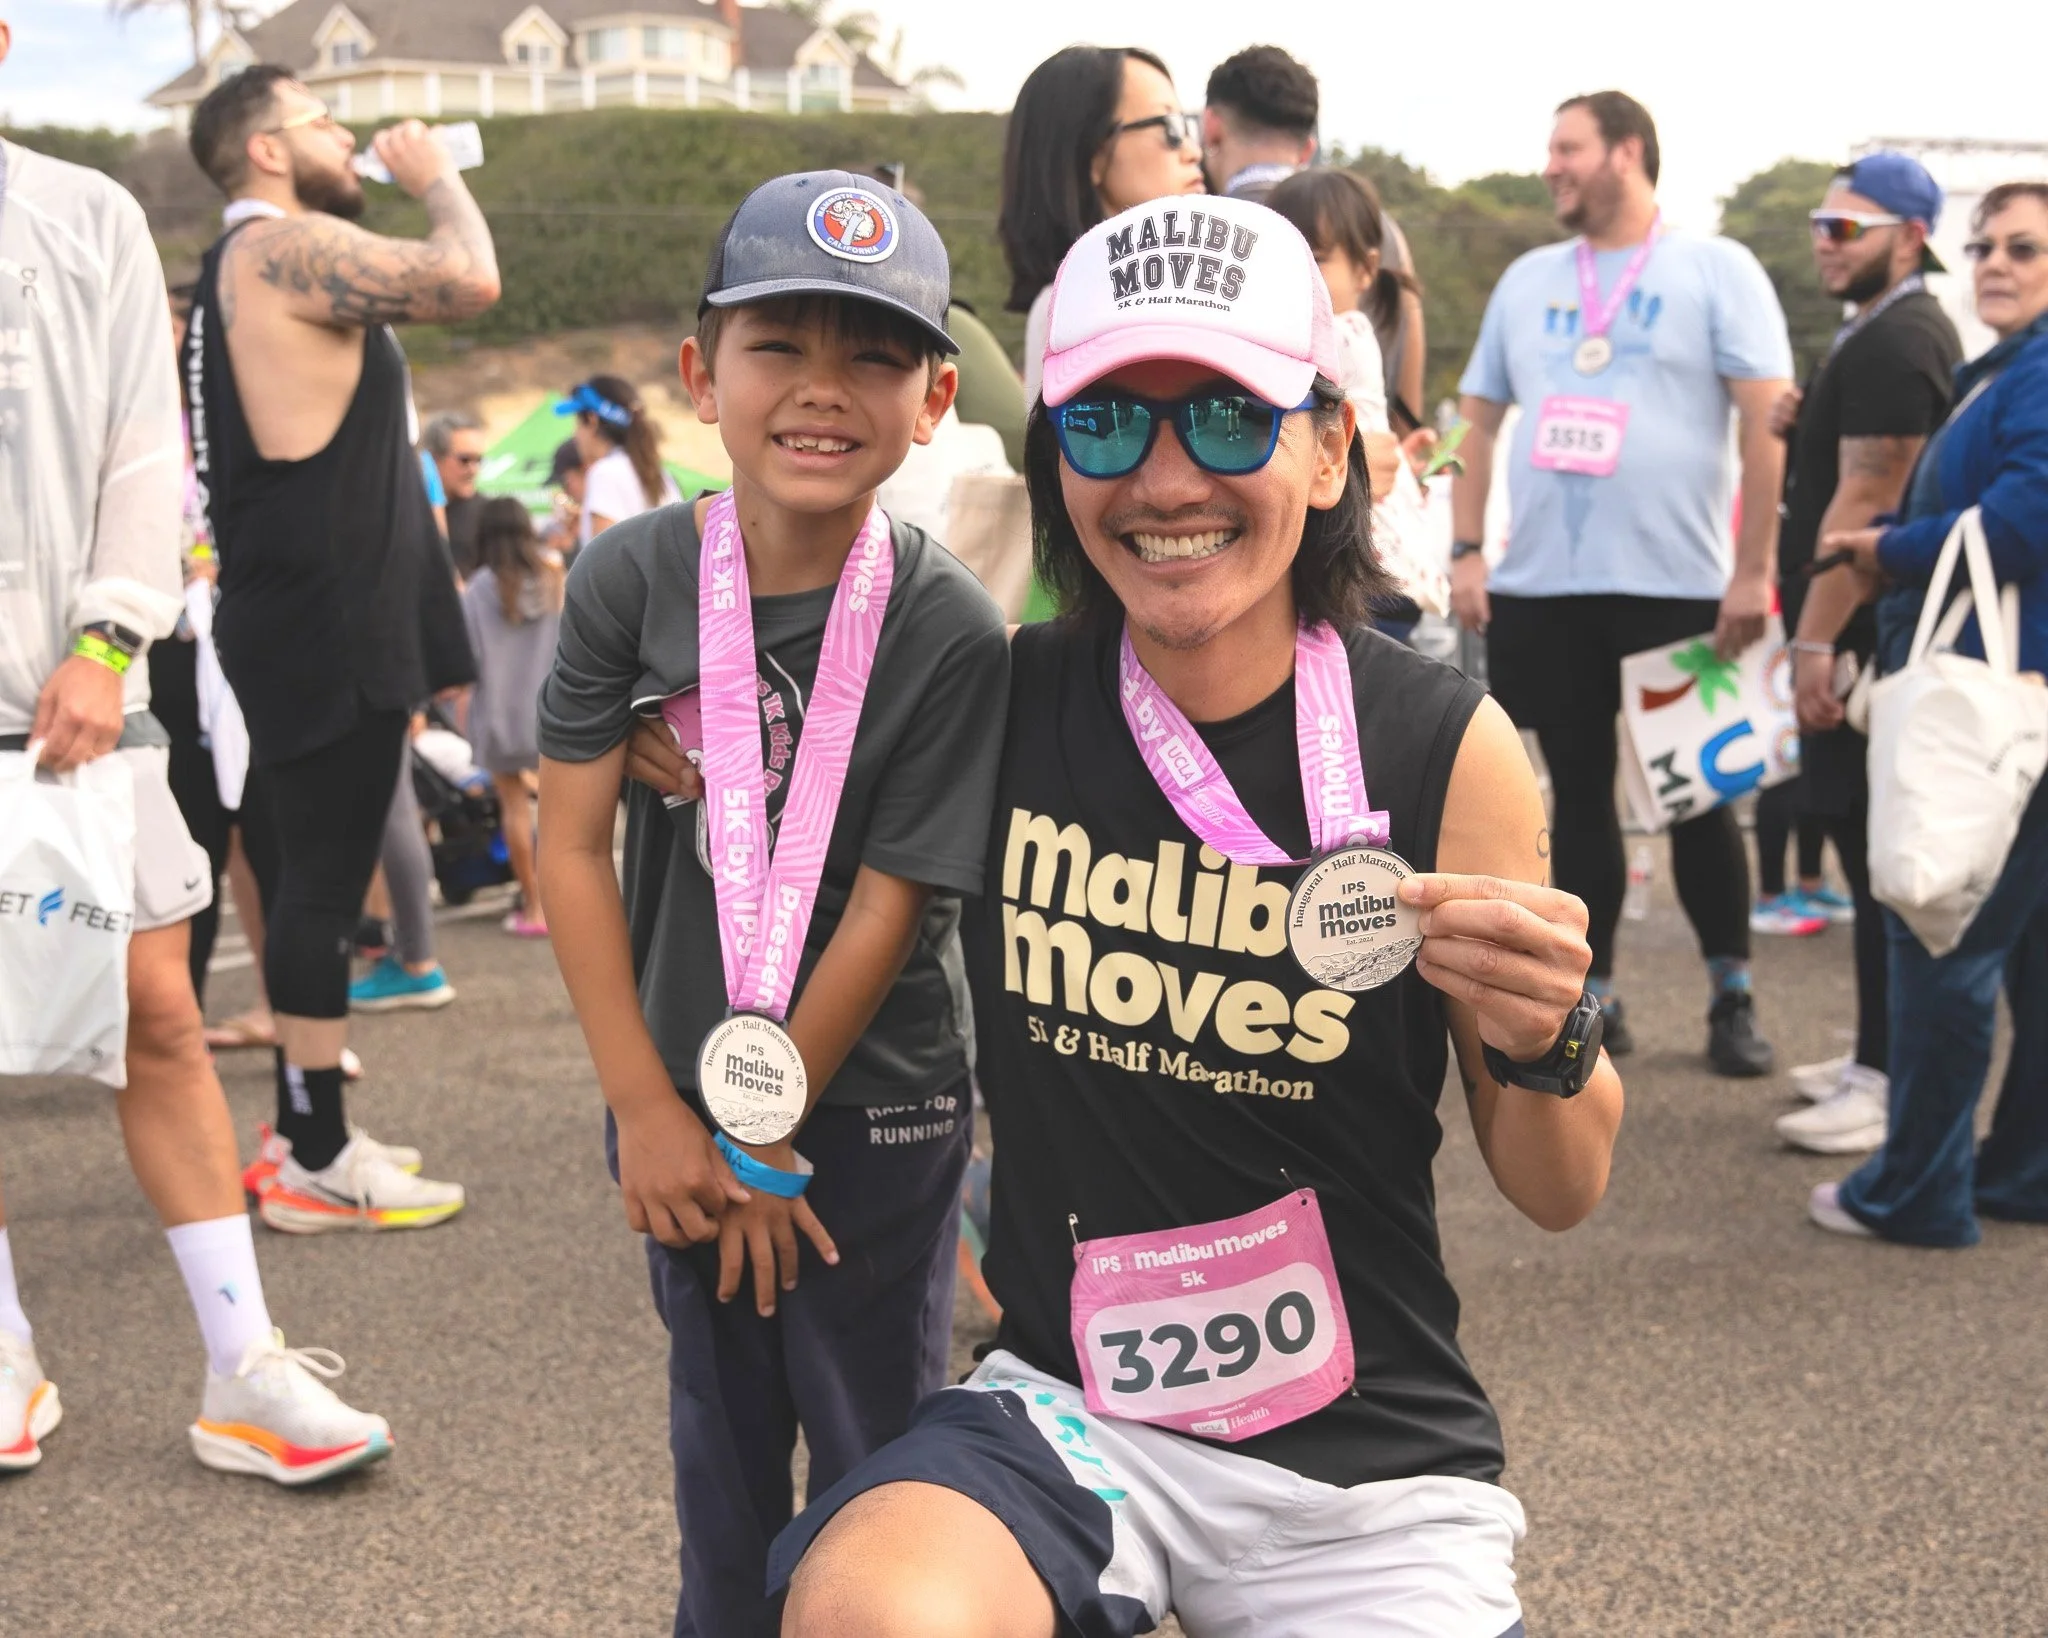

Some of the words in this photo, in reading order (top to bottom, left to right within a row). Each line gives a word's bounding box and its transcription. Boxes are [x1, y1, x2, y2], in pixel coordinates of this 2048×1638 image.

[816, 193, 853, 218] MAMMOTH
[859, 195, 892, 232] MOUNTAIN
[826, 236, 880, 255] CALIFORNIA
[1105, 211, 1258, 265] MALIBU
[1109, 252, 1246, 301] MOVES
[1117, 299, 1132, 311] 5K
[1135, 297, 1146, 306] &
[1148, 296, 1174, 305] Half
[1175, 296, 1231, 312] Marathon
[712, 520, 735, 560] by
[712, 565, 736, 611] 5K
[762, 692, 785, 724] 1K
[768, 722, 793, 770] Kids
[1136, 695, 1167, 742] by
[1167, 745, 1195, 783] UCLA
[1189, 781, 1226, 828] Health
[1318, 714, 1353, 817] moves
[723, 787, 752, 834] 5K
[724, 844, 755, 889] by
[1002, 807, 1292, 958] malib
[1342, 881, 1366, 895] IPS
[1293, 872, 1324, 929] Inaugural
[1331, 855, 1357, 872] Half
[1319, 895, 1396, 922] malibu
[732, 901, 760, 958] IPS
[754, 883, 803, 1009] Presen
[1320, 913, 1397, 939] moves
[1002, 902, 1356, 1064] moves
[705, 1025, 735, 1068] Inaugural
[742, 1020, 762, 1031] Half
[762, 1023, 798, 1065] Marathon
[746, 1043, 765, 1057] IPS
[1054, 1024, 1081, 1056] &
[1087, 1031, 1153, 1073] Half
[724, 1068, 784, 1097] moves
[725, 1053, 785, 1081] malibu
[869, 1118, 955, 1145] RUNNING
[1092, 1255, 1121, 1275] IPS
[1099, 1289, 1316, 1395] 3290
[1196, 1423, 1225, 1432] UCLA
[1230, 1406, 1271, 1429] Health
